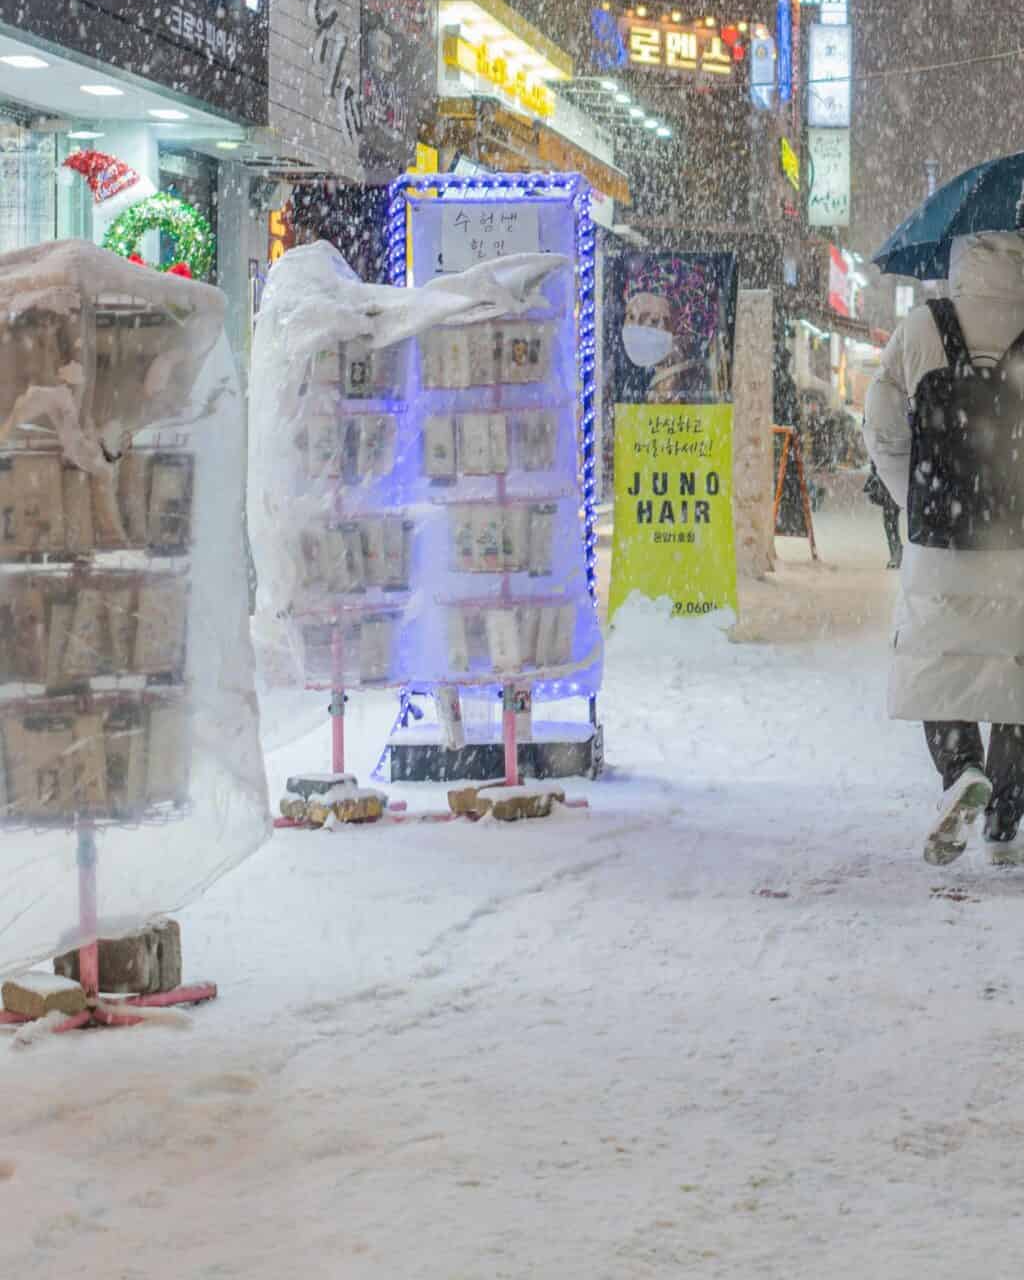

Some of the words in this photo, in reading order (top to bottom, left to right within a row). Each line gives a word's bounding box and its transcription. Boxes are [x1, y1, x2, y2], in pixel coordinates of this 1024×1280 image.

[630, 24, 732, 75] 로멘스
[627, 471, 720, 496] JUNO
[636, 499, 711, 525] HAIR
